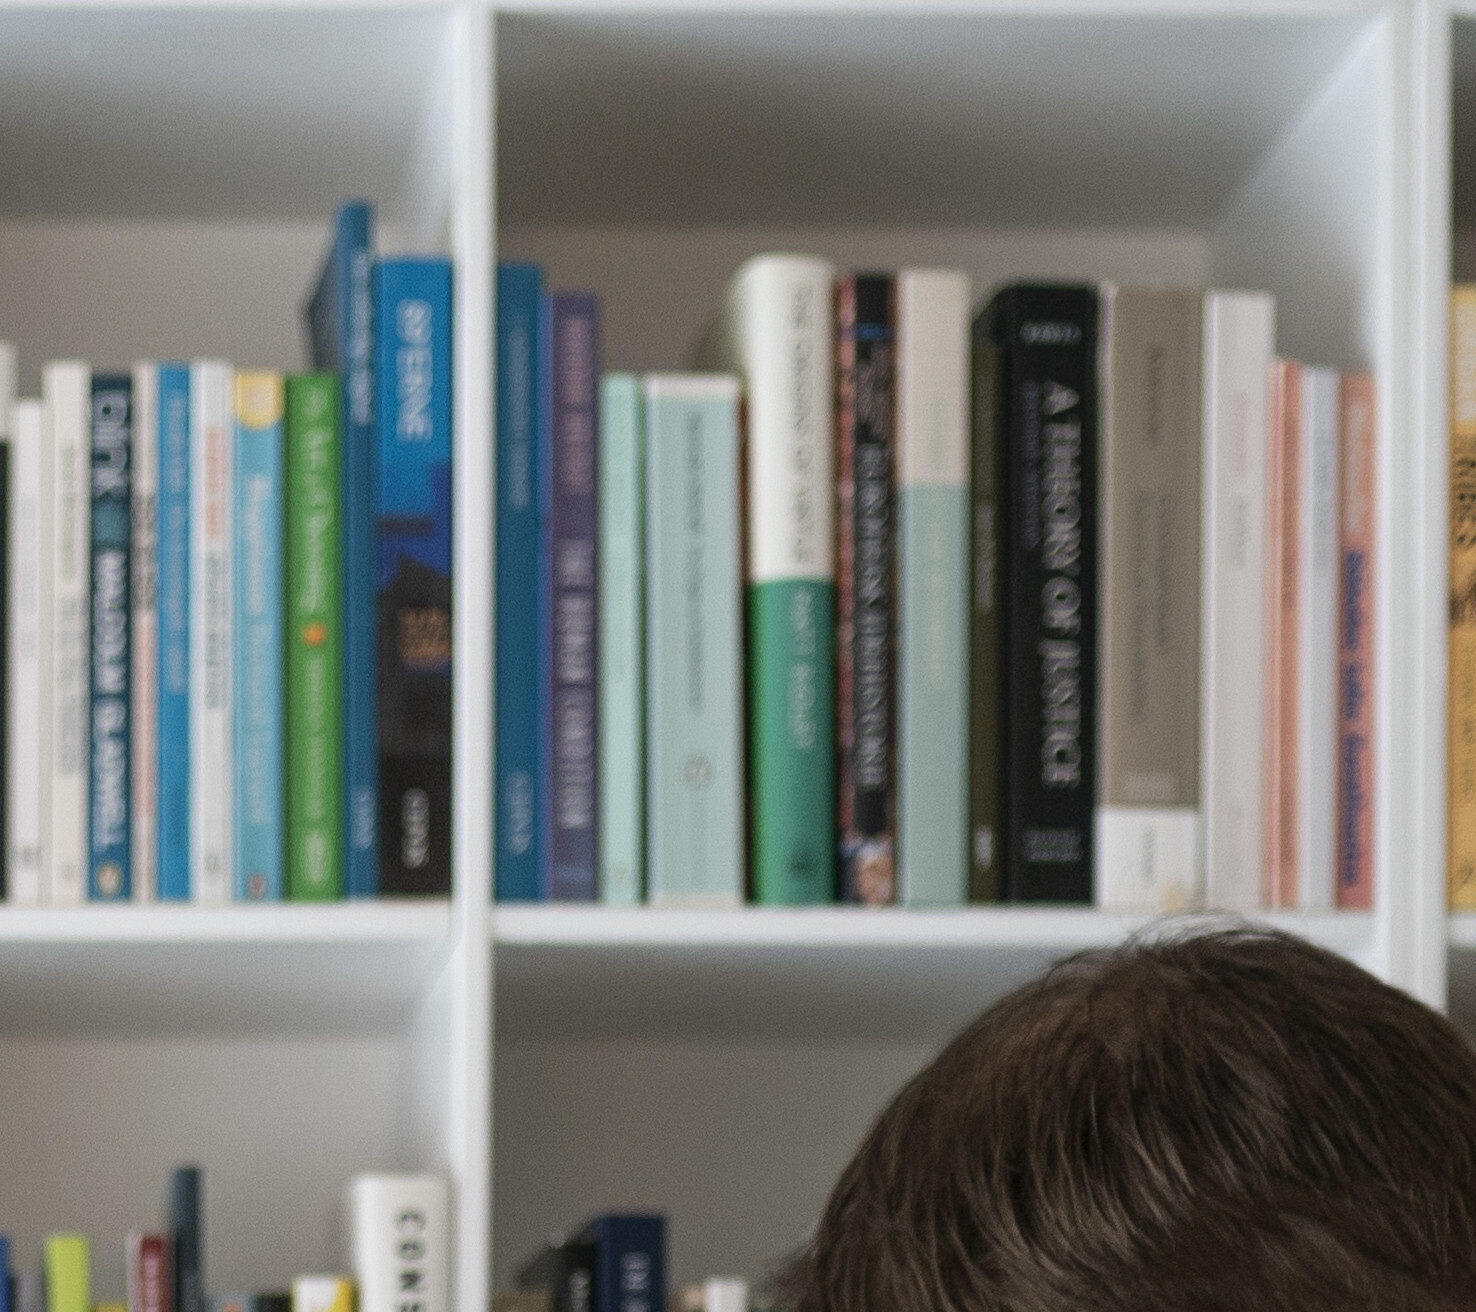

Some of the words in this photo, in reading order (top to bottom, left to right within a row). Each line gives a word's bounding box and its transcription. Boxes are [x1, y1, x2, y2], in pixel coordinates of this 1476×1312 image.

[1043, 380, 1080, 415] A
[1042, 422, 1081, 572] THEORY
[1042, 577, 1081, 631] OF
[1038, 638, 1081, 790] JUSTICE
